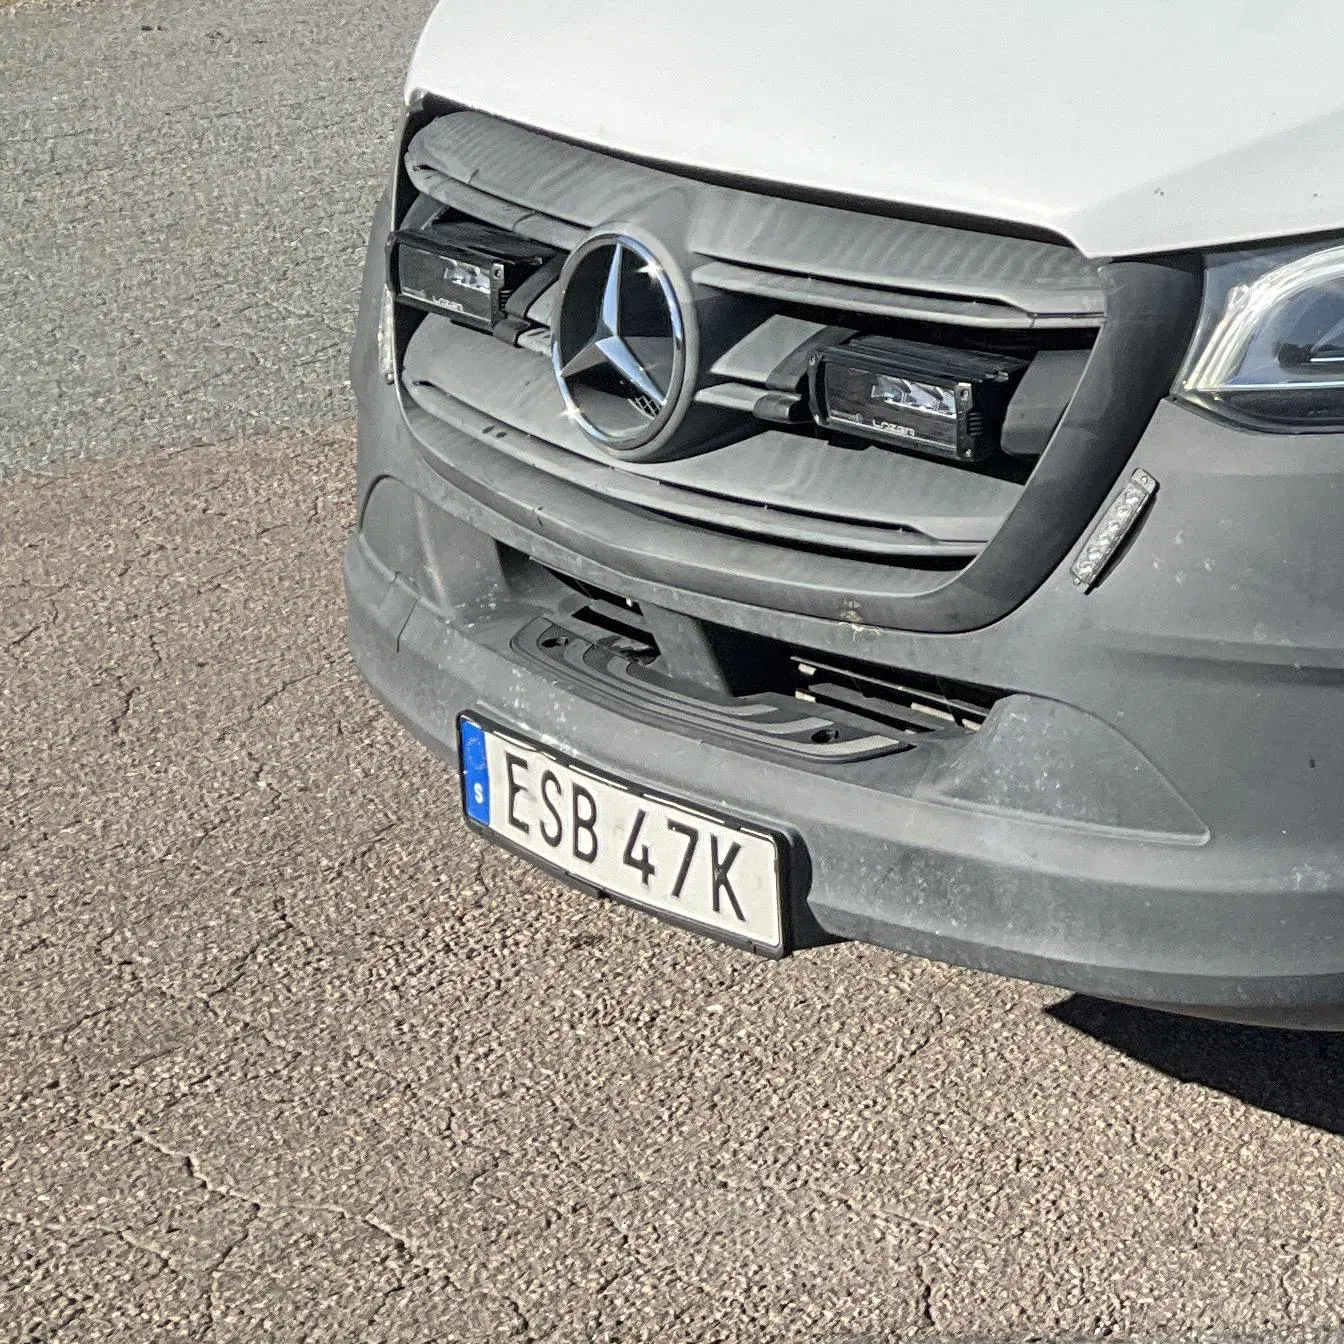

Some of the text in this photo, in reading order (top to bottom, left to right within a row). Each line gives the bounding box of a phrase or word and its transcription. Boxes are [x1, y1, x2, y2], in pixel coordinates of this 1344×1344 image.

[473, 782, 484, 805] S
[505, 751, 747, 923] ESB 47K
